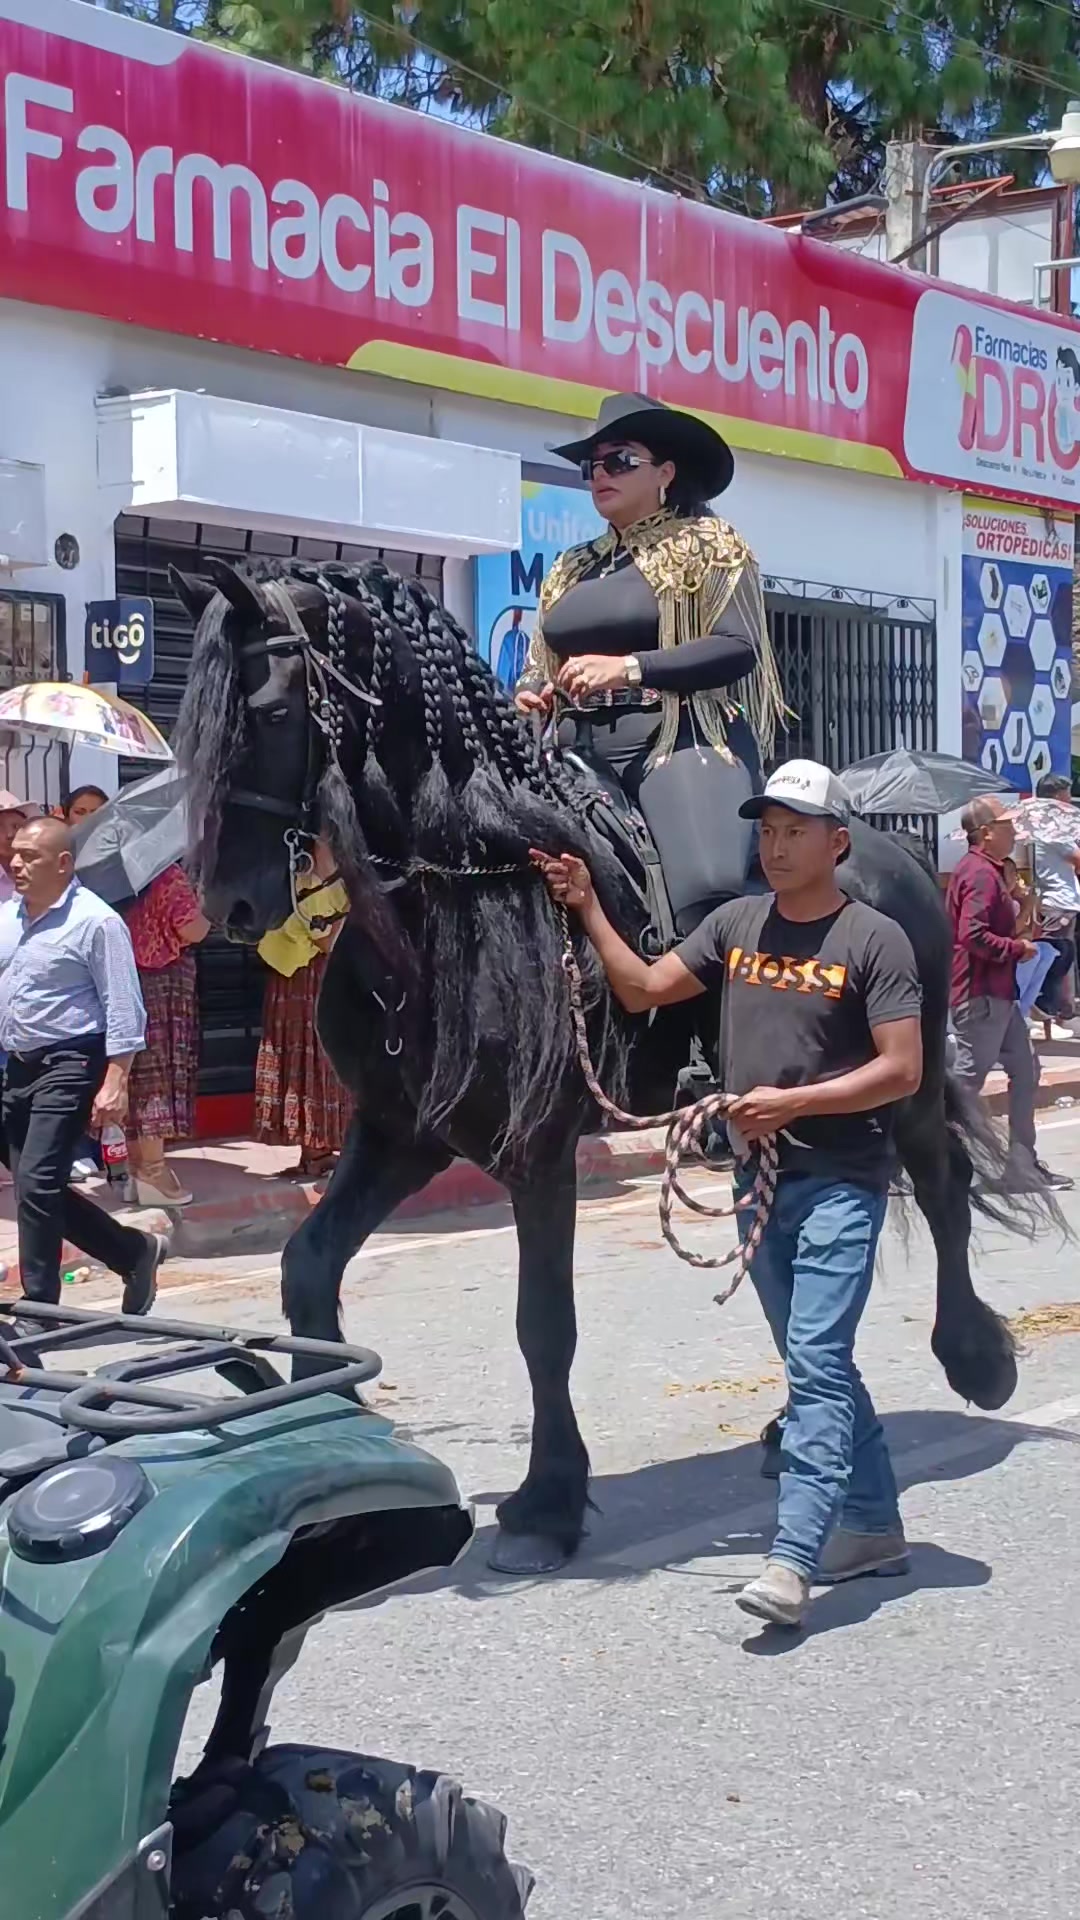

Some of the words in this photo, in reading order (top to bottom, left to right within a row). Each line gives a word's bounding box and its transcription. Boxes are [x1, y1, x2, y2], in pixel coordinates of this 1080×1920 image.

[5, 72, 434, 307] Farmacia
[457, 204, 521, 330] El
[542, 229, 869, 410] Descuento
[975, 326, 1048, 371] Farmacias
[731, 947, 846, 998] BOSS
